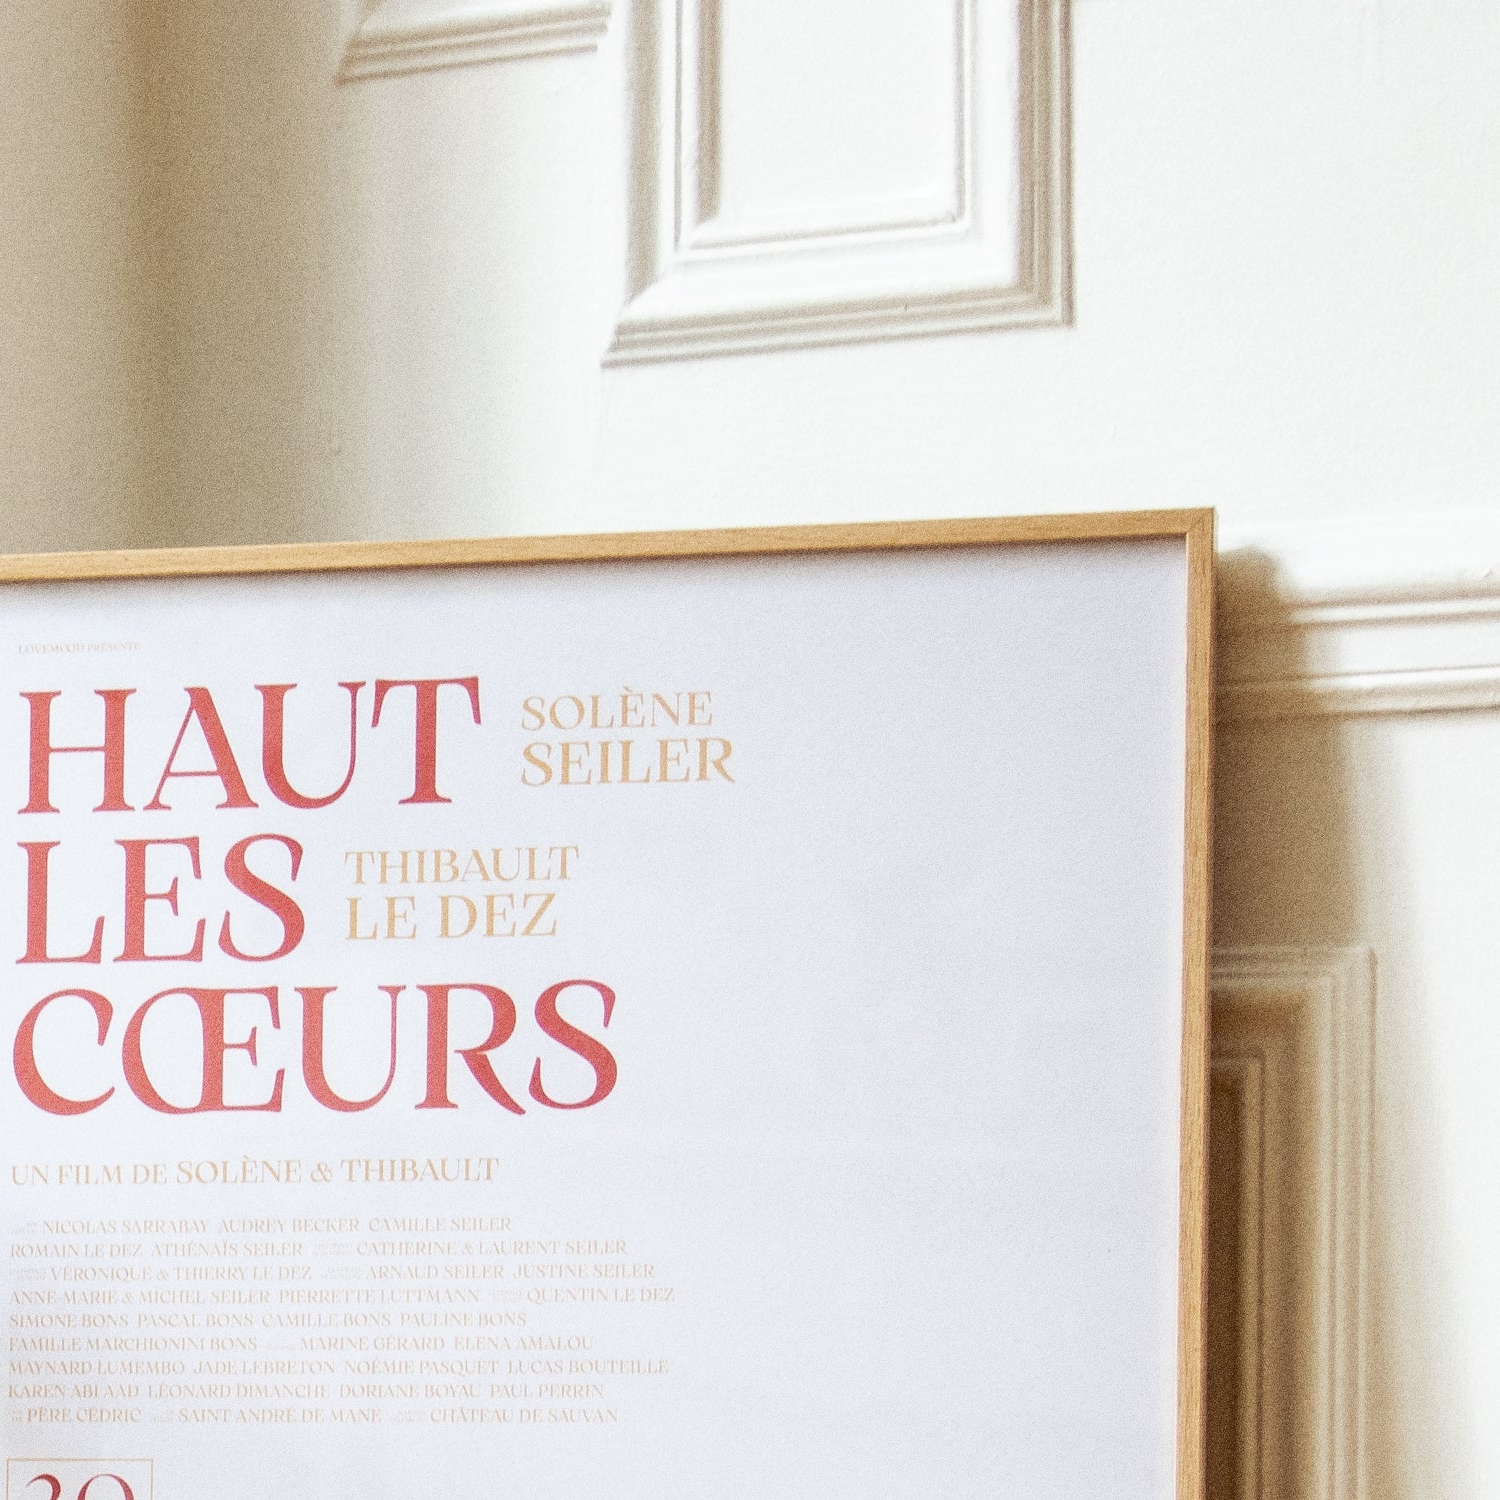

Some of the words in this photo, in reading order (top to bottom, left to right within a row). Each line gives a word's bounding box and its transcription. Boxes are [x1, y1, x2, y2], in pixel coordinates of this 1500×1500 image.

[521, 685, 713, 731] SOLÈNE
[17, 676, 482, 814] HAUT
[520, 737, 736, 787] SEILER
[344, 844, 580, 885] THIBAULT
[15, 833, 305, 964] LES
[346, 895, 417, 941] LE
[437, 892, 557, 939] DEZ
[13, 980, 617, 1115] CŒURS
[11, 1165, 48, 1186] UN
[58, 1164, 122, 1185] FILM
[132, 1163, 167, 1184] DE
[176, 1155, 302, 1184] SOLÈNE
[310, 1162, 333, 1183] &
[340, 1157, 500, 1183] THIBAULT
[43, 1220, 116, 1234] NICOLAS
[122, 1220, 208, 1233] SARRABAY
[219, 1218, 286, 1233] AUDREY
[292, 1218, 360, 1232] BECKER
[368, 1218, 445, 1232] CAMILLE
[451, 1217, 511, 1231] SEILER
[11, 1244, 79, 1258] ROMAIN
[84, 1244, 104, 1257] LE
[109, 1244, 142, 1257] DEZ
[243, 1243, 302, 1256] SEILER
[357, 1241, 456, 1256] CATHERINE
[462, 1242, 473, 1255] &
[478, 1240, 561, 1255] LAURENT
[565, 1239, 628, 1254] SEILER
[51, 1265, 151, 1283] VÉRONIQUE
[156, 1269, 169, 1280] &
[173, 1266, 246, 1280] THIERRY
[253, 1267, 271, 1280] LE
[279, 1266, 312, 1280] DEZ
[367, 1265, 438, 1279] ARNAUD
[444, 1265, 504, 1279] SEILER
[513, 1264, 586, 1278] JUSTINE
[593, 1263, 655, 1278] SEILER
[122, 1293, 134, 1303] &
[139, 1290, 205, 1304] MICHEL
[211, 1290, 270, 1304] SEILER
[279, 1289, 376, 1303] PIERRETTE
[381, 1289, 479, 1303] LUTTMANN
[527, 1288, 608, 1305] QUENTIN
[614, 1288, 635, 1302] LE
[640, 1287, 675, 1302] DEZ
[10, 1314, 76, 1328] SIMONE
[82, 1314, 128, 1327] BONS
[138, 1314, 200, 1327] PASCAL
[206, 1314, 253, 1327] BONS
[262, 1313, 336, 1327] CAMILLE
[343, 1313, 391, 1327] BONS
[400, 1313, 473, 1326] PAULINE
[478, 1312, 526, 1327] BONS
[9, 1337, 81, 1352] FAMILLE
[87, 1337, 205, 1351] MARCHIONINI
[210, 1337, 257, 1351] BONS
[300, 1337, 368, 1351] MARINE
[373, 1335, 445, 1350] GÉRARD
[9, 1360, 92, 1375] MAYNARD
[193, 1361, 237, 1374] JADE
[242, 1361, 335, 1375] LEBRETON
[345, 1358, 413, 1374] NOÉMIE
[419, 1360, 500, 1377] PASQUET
[507, 1360, 563, 1374] LUCAS
[568, 1359, 669, 1375] BOUTEILLE
[8, 1384, 66, 1399] KAREN
[72, 1384, 99, 1398] ABI
[104, 1385, 139, 1398] AAD
[148, 1382, 231, 1398] LÉONARD
[236, 1384, 330, 1398] DIMANCHE
[339, 1384, 419, 1398] DORIANE
[490, 1384, 533, 1398] PAUL
[538, 1384, 603, 1398] PERRIN
[75, 1406, 142, 1423] CÉDRIC
[179, 1408, 232, 1423] SAINT
[235, 1407, 297, 1424] ANDRÉ
[302, 1409, 325, 1423] DE
[331, 1408, 381, 1423] MANE
[519, 1408, 542, 1423] DE
[548, 1409, 618, 1423] SAUVAN
